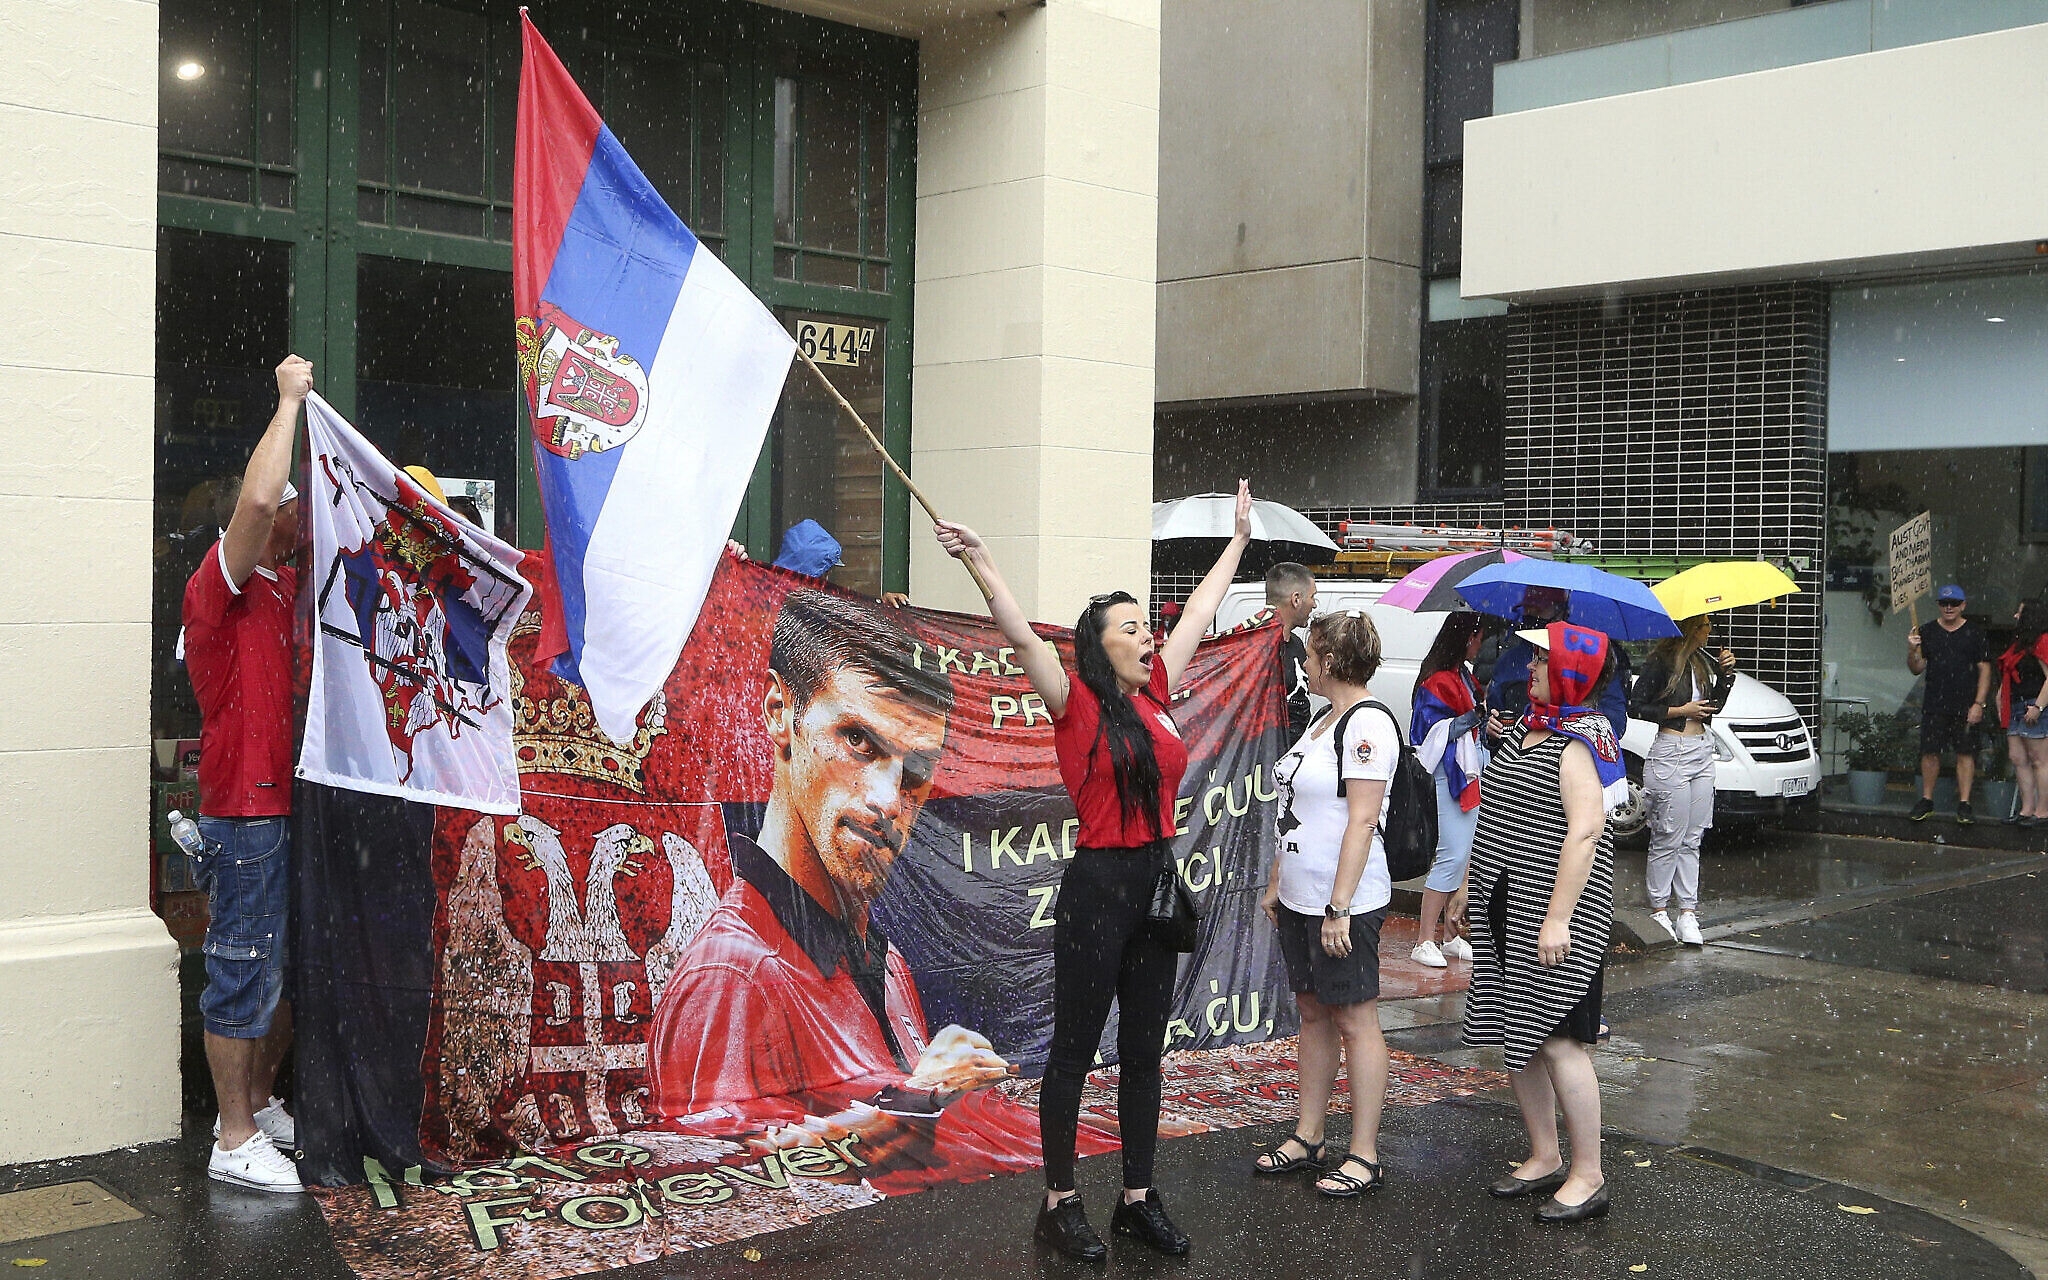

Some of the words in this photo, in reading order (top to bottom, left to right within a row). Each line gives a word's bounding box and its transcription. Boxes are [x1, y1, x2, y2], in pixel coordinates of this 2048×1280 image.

[1891, 526, 1913, 552] AUST
[1895, 545, 1909, 562] AND
[1908, 537, 1930, 556] MEDIA
[1891, 563, 1903, 581] BIG
[1905, 551, 1930, 571] PHARMA
[1892, 572, 1915, 593] OWNED
[1894, 591, 1909, 607] LIES
[1913, 578, 1929, 594] LIES
[912, 642, 923, 670] I
[962, 832, 973, 873] I
[466, 1132, 868, 1251] Forever
